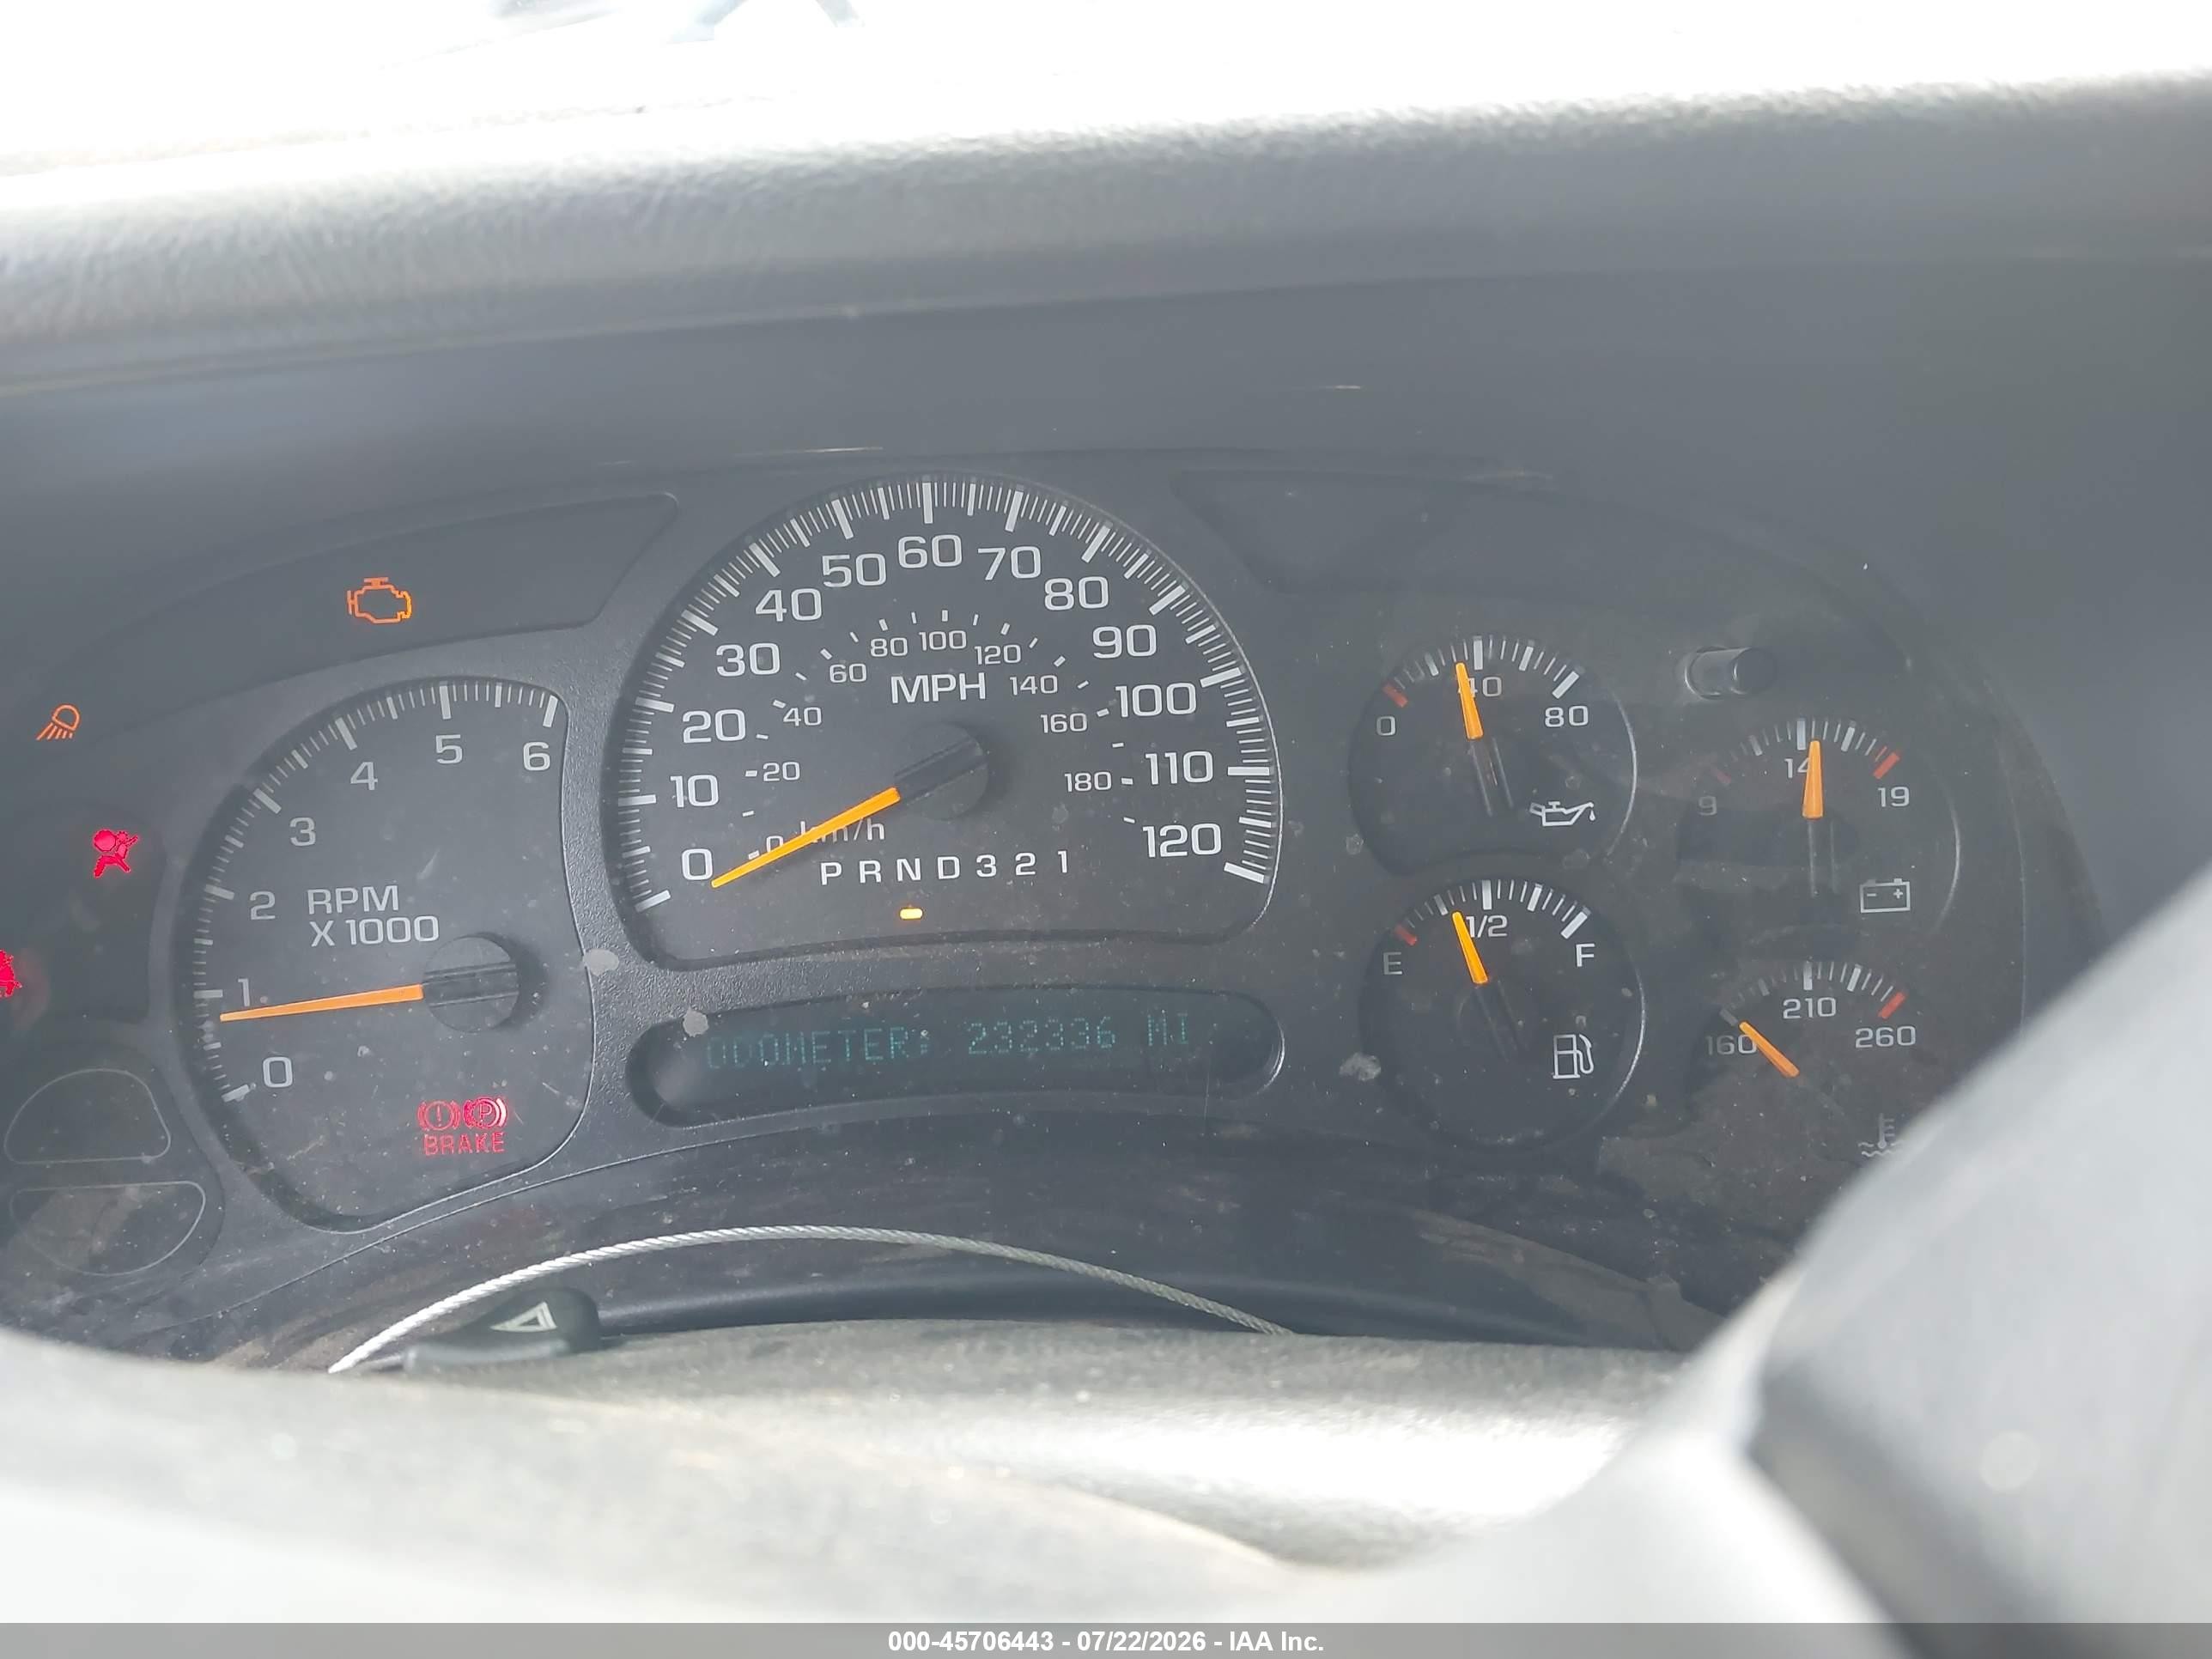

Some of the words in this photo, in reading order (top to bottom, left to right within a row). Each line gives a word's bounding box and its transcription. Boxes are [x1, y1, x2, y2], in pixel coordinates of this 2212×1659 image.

[898, 533, 963, 568] 60
[977, 545, 1042, 581] 70
[822, 553, 887, 588] 50
[755, 587, 823, 623] 40
[1044, 576, 1109, 611] 80
[870, 636, 908, 658] 80
[919, 629, 968, 652] 100
[974, 643, 1022, 665] 120
[1092, 623, 1158, 659] 90
[716, 642, 781, 677] 30
[829, 662, 867, 684] 60
[890, 672, 987, 704] MPH
[1009, 674, 1059, 696] 140
[1115, 682, 1197, 718] 100
[682, 708, 746, 744] 20
[783, 706, 823, 727] 40
[1040, 712, 1088, 734] 160
[1376, 715, 1397, 737] 0
[1545, 704, 1589, 728] 80
[434, 733, 464, 765] 5
[522, 740, 550, 771] 6
[349, 761, 379, 791] 4
[762, 761, 801, 782] 20
[1064, 771, 1113, 793] 180
[1145, 750, 1213, 786] 110
[670, 774, 720, 809] 10
[1698, 794, 1718, 817] 9
[1877, 786, 1911, 808] 19
[289, 816, 317, 848] 3
[1142, 822, 1222, 859] 120
[681, 848, 714, 881] 0
[821, 861, 842, 886] P
[859, 860, 883, 884] R
[896, 858, 921, 882] N
[937, 855, 961, 879] D
[975, 854, 997, 878] 3
[1015, 852, 1036, 876] 2
[1057, 850, 1068, 873] 1
[249, 890, 276, 921] 2
[307, 884, 399, 915] RPM
[311, 921, 335, 947] X
[345, 915, 440, 945] 1000
[1465, 914, 1508, 939] 1/2
[1382, 951, 1403, 975] E
[1575, 943, 1595, 968] F
[237, 977, 252, 1006] 1
[1782, 997, 1837, 1020] 210
[967, 1015, 1116, 1055] 232336
[1147, 1012, 1188, 1047] MI
[1705, 1034, 1758, 1056] 160
[1855, 1024, 1917, 1048] 260
[262, 1055, 294, 1089] 0
[423, 1132, 505, 1157] BRAKE
